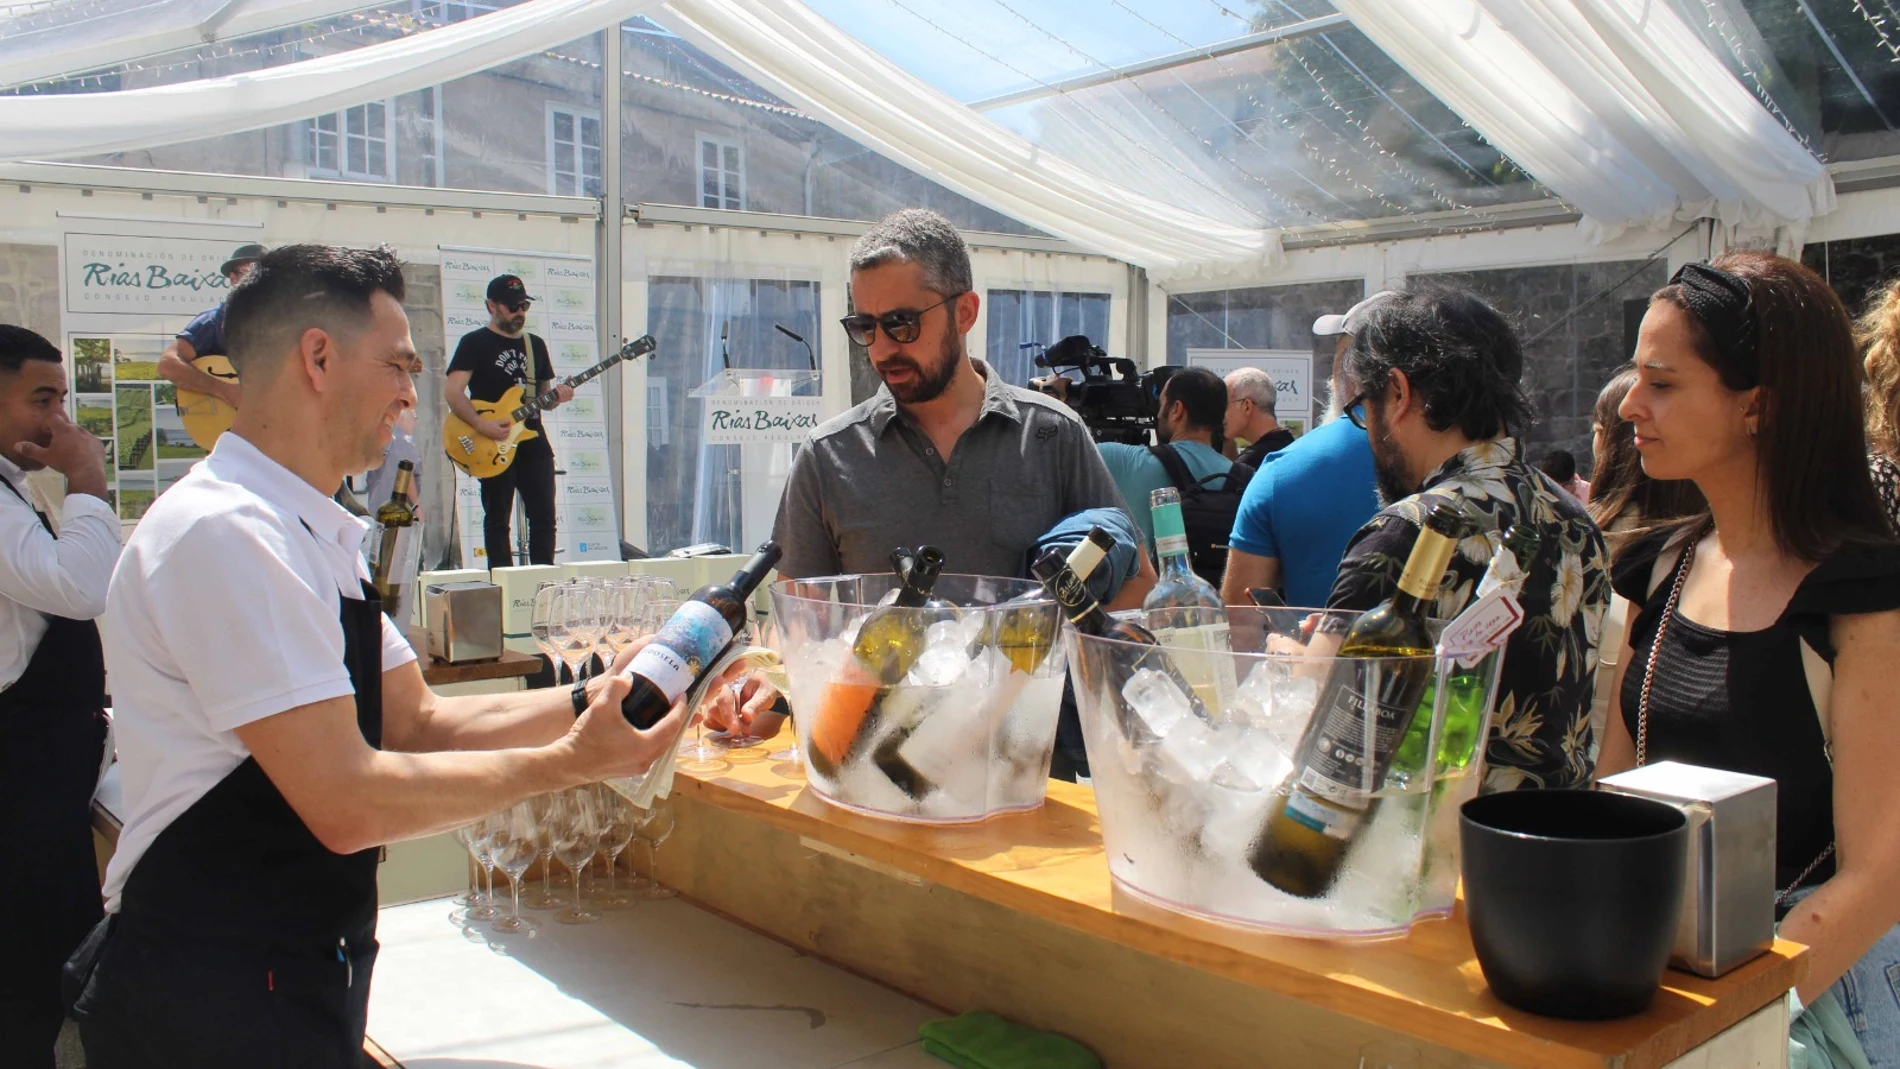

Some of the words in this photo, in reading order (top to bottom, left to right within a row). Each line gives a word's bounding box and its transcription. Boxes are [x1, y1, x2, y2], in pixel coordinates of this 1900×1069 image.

[83, 250, 174, 260] DENOMINACIÓN
[146, 264, 230, 291] Baixa
[84, 292, 150, 301] CONSEJO
[161, 295, 226, 303] REGULAD
[753, 410, 818, 431] Baixas
